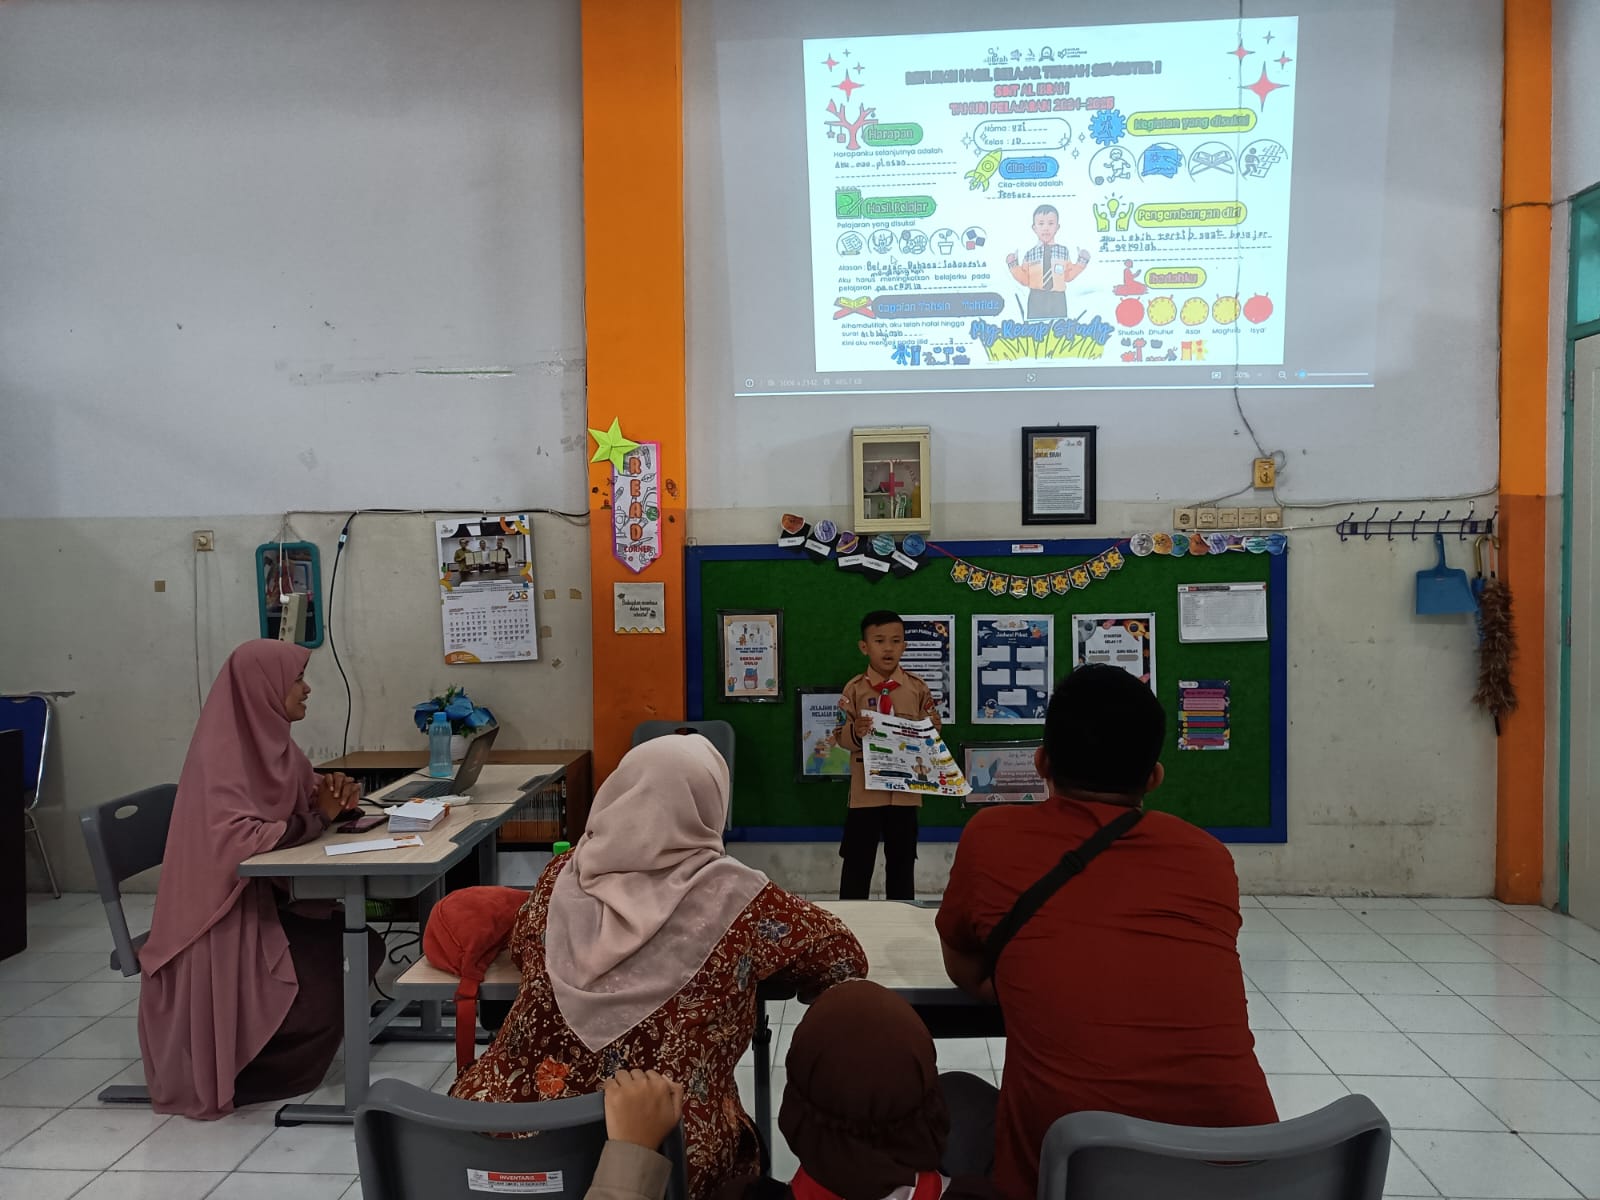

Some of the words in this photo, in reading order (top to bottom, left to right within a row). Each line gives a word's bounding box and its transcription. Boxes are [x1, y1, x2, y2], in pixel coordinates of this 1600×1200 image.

[984, 124, 1007, 132] Nama
[1182, 118, 1210, 130] yang
[867, 128, 914, 141] Harapan
[984, 138, 1004, 146] Kelas
[833, 150, 874, 159] Harapanku
[875, 148, 916, 158] selanjutnya
[917, 147, 943, 155] adalah
[997, 181, 1037, 189] Cita-citaku
[866, 202, 893, 214] Hasil
[893, 201, 929, 214] Belajar
[1138, 208, 1221, 222] Pengembangan
[837, 221, 871, 230] Pelajaran
[872, 221, 890, 229] yang
[891, 220, 916, 228] disukai
[855, 276, 876, 284] harus
[880, 274, 930, 283] meningkatkan
[935, 273, 967, 282] belajarku
[971, 273, 991, 281] pada
[838, 284, 872, 293] pelajaran
[940, 320, 965, 328] hingga
[970, 319, 999, 347] My
[1052, 315, 1114, 345] Study
[628, 456, 643, 541] READ
[624, 545, 652, 553] CORNER
